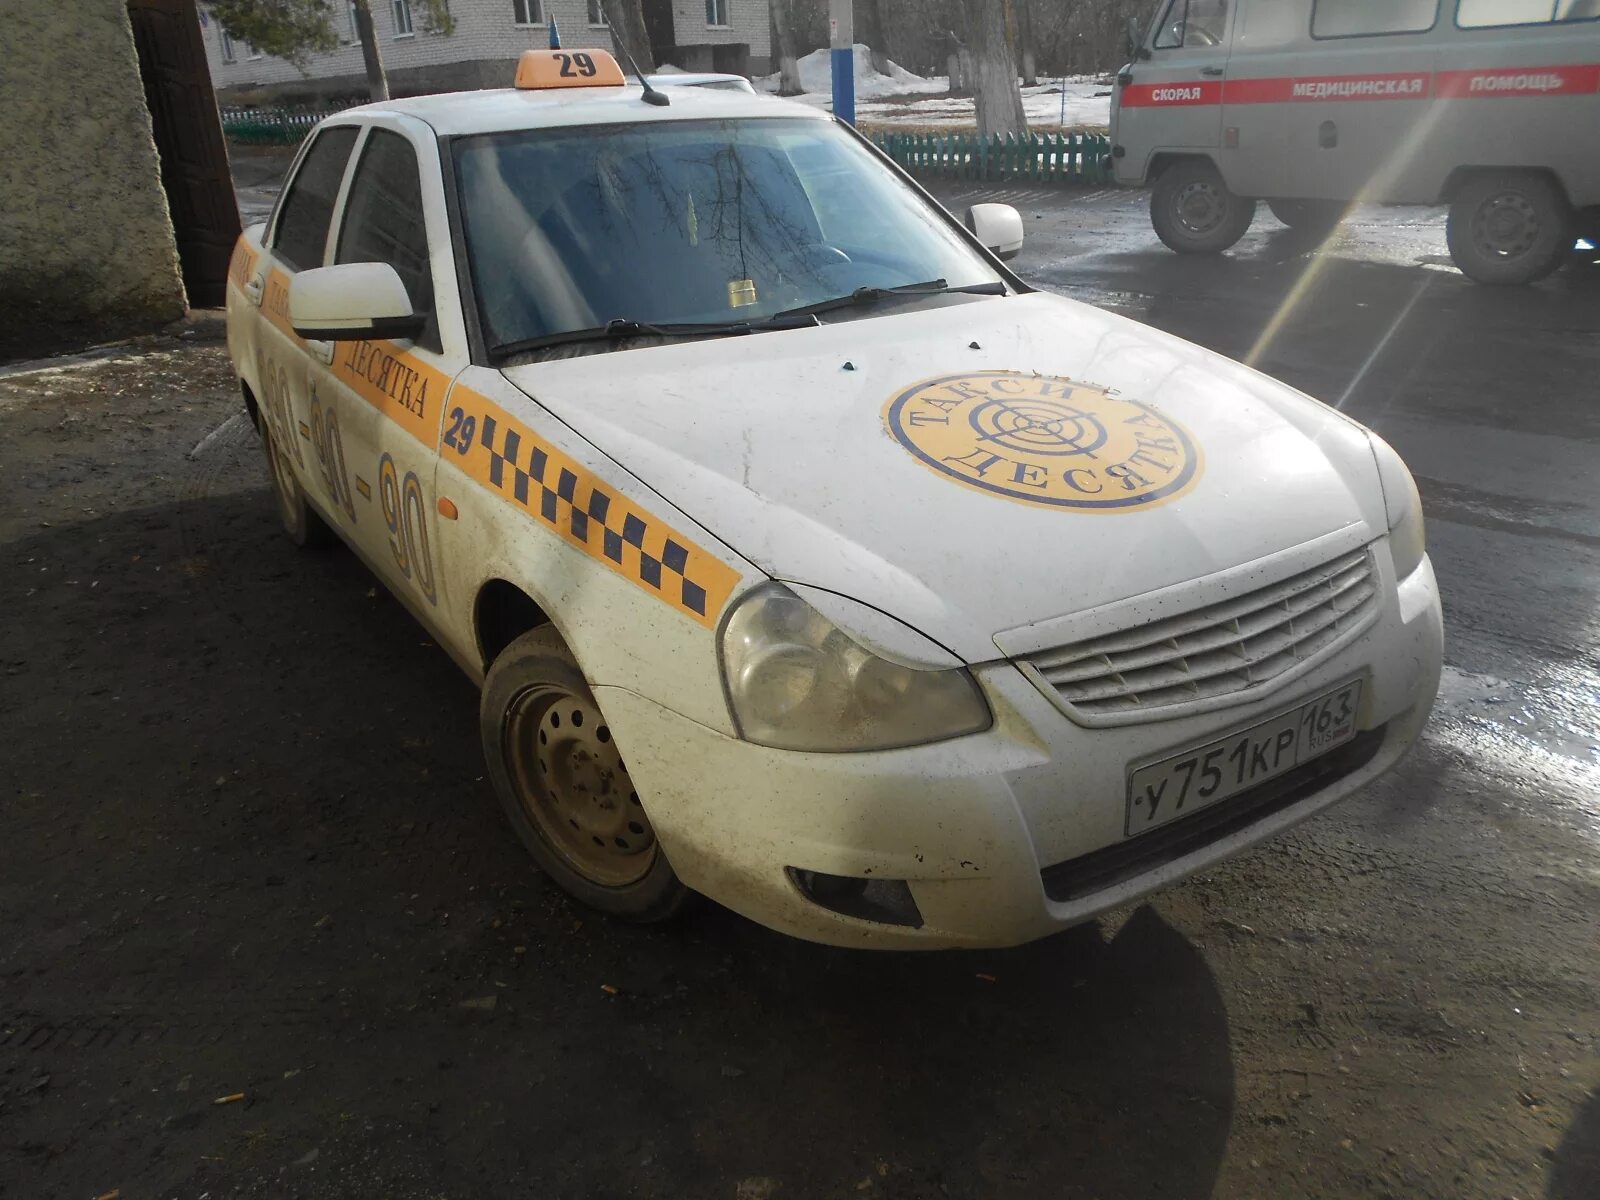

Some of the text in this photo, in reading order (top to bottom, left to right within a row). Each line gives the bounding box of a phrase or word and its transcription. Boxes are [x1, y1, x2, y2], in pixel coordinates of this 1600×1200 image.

[552, 52, 597, 78] 29
[1152, 73, 1563, 102] СКОРАЯ МЕДИЦИНСКАЯ ПОМОЩЬ
[344, 340, 429, 419] ДЕСЯТКА
[909, 379, 1073, 427] ТАКСИ
[444, 407, 476, 455] 29
[942, 412, 1182, 495] ДЕСЯТКА
[1145, 689, 1352, 821] У751КР 163
